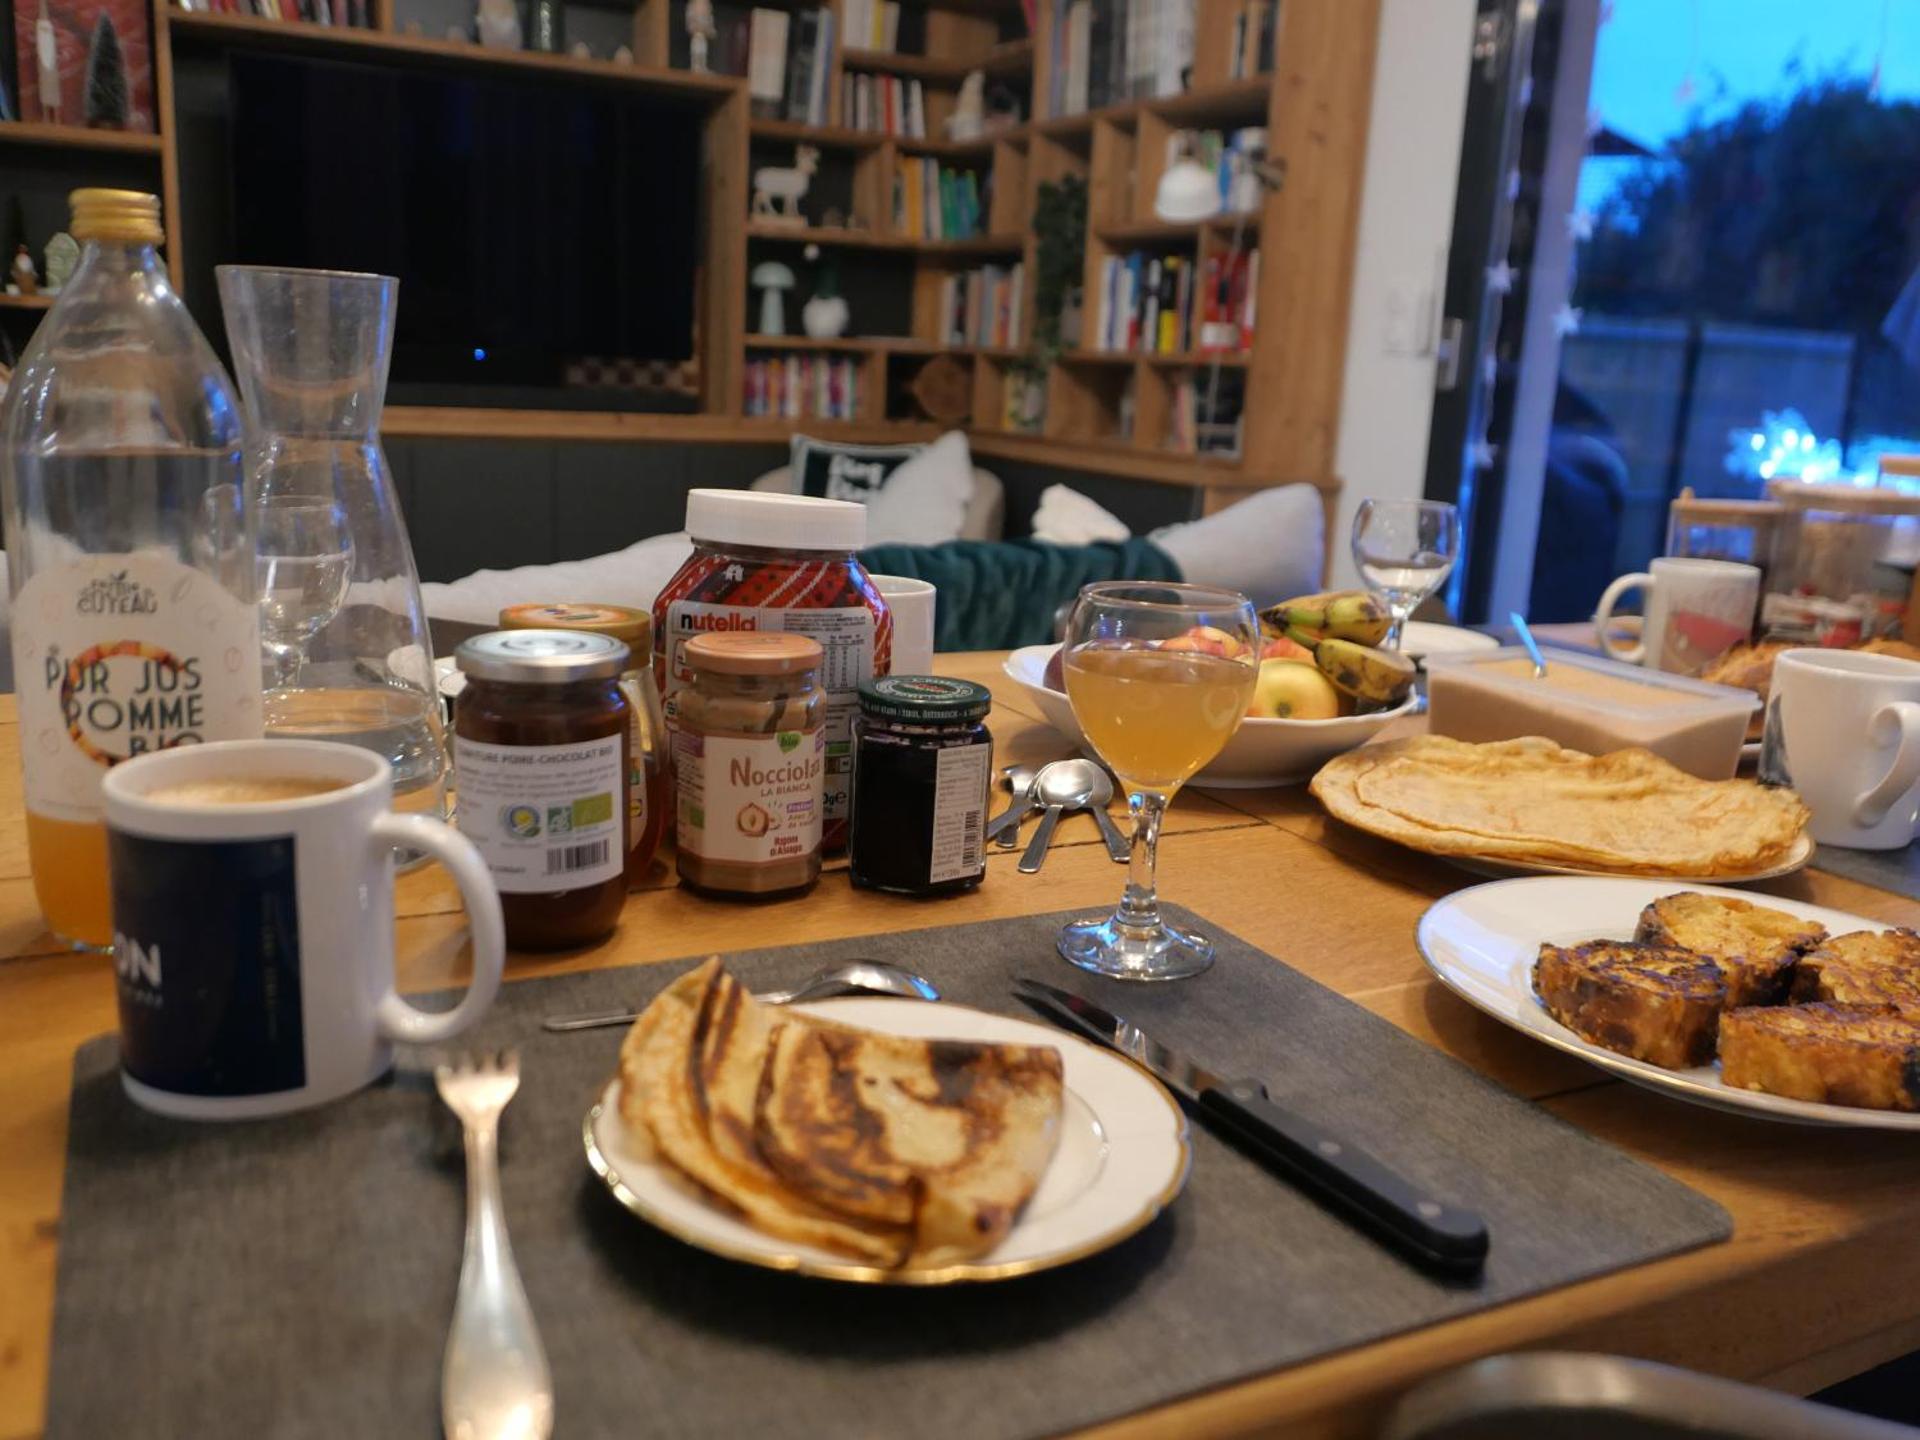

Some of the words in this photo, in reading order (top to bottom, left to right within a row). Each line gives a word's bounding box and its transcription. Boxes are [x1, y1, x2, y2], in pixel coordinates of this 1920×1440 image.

[681, 613, 756, 632] nutella
[46, 656, 110, 695] PUR
[135, 657, 201, 695] JUS
[66, 694, 204, 732] POMME
